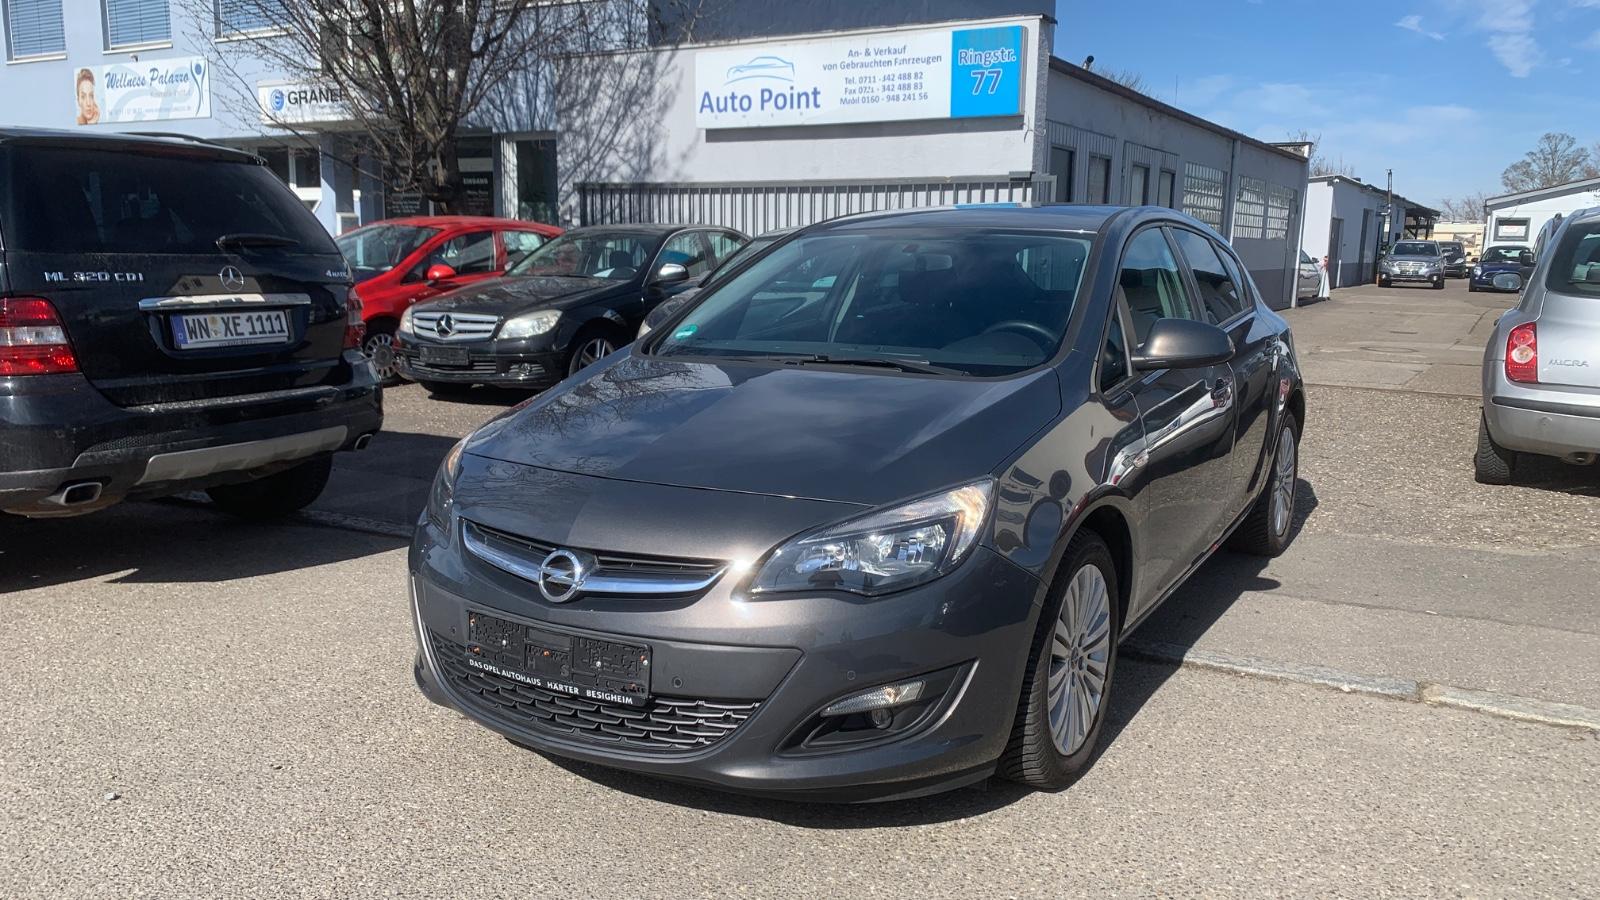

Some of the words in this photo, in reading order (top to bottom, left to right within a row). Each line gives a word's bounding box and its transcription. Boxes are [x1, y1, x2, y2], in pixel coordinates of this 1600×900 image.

[864, 48, 871, 56] &
[874, 45, 907, 56] Verkauf
[958, 48, 1016, 67] Ringstr.
[822, 63, 838, 71] von
[840, 58, 892, 70] Gebrauchten
[105, 72, 146, 89] Wellness
[149, 67, 189, 87] Palazzo
[845, 76, 857, 85] Tel.
[858, 75, 876, 84] 0711
[897, 72, 912, 81] 488
[913, 71, 924, 80] 82
[971, 69, 1002, 95] 77
[844, 87, 856, 95] Fax
[881, 84, 895, 92] 342
[897, 83, 912, 91] 488
[913, 82, 923, 90] 83
[699, 91, 752, 113] Auto
[760, 86, 822, 111] Point
[861, 95, 880, 104] 0160
[886, 94, 900, 102] 948
[902, 93, 916, 101] 241
[918, 92, 928, 100] 56
[44, 271, 69, 282] ML
[73, 271, 110, 282] 320
[114, 272, 144, 282] CDI
[185, 318, 211, 340] WN
[221, 316, 245, 337] XE
[246, 314, 286, 336] 1111
[1548, 359, 1590, 368] MICRA
[468, 658, 483, 669] DAS
[483, 662, 501, 675] OPEL
[501, 668, 541, 686] AUTOHAUS
[547, 680, 579, 695] HÄRTER
[586, 689, 633, 705] BESIGHEIM
